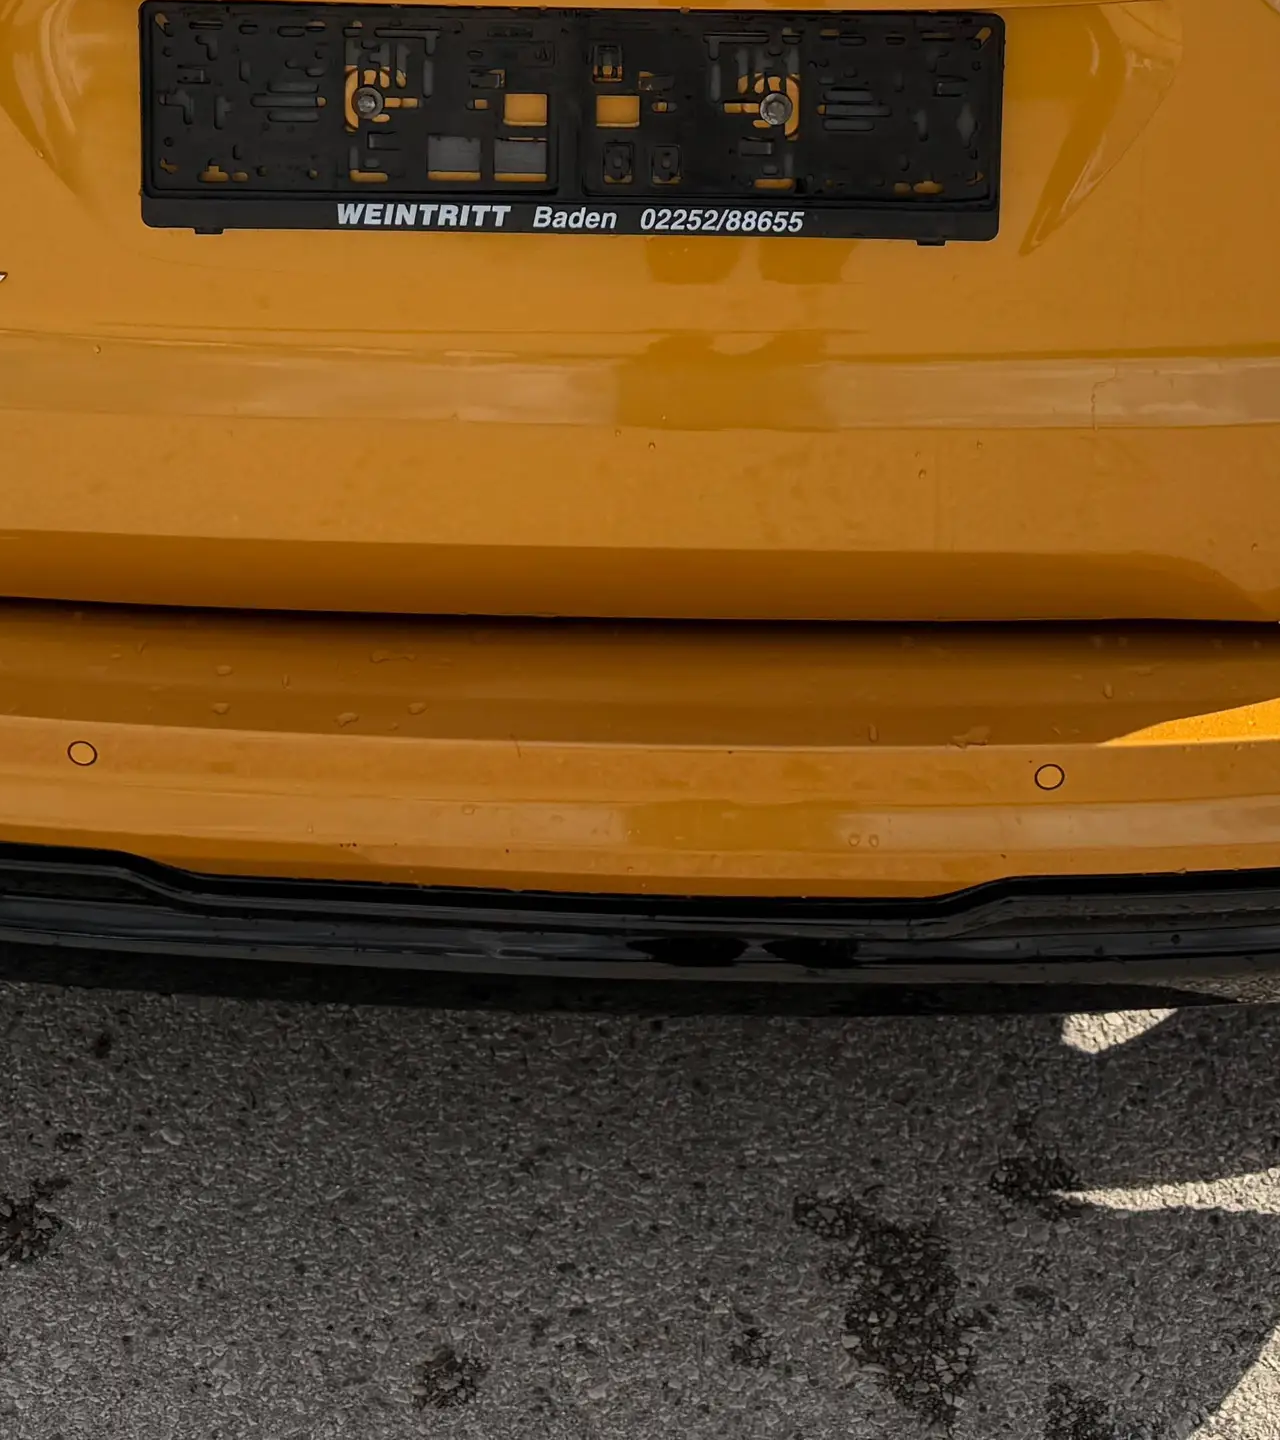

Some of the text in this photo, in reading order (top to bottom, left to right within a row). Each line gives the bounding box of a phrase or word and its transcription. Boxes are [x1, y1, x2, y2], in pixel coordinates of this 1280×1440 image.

[336, 202, 806, 233] WEINTRITT Baden 02252/88655
